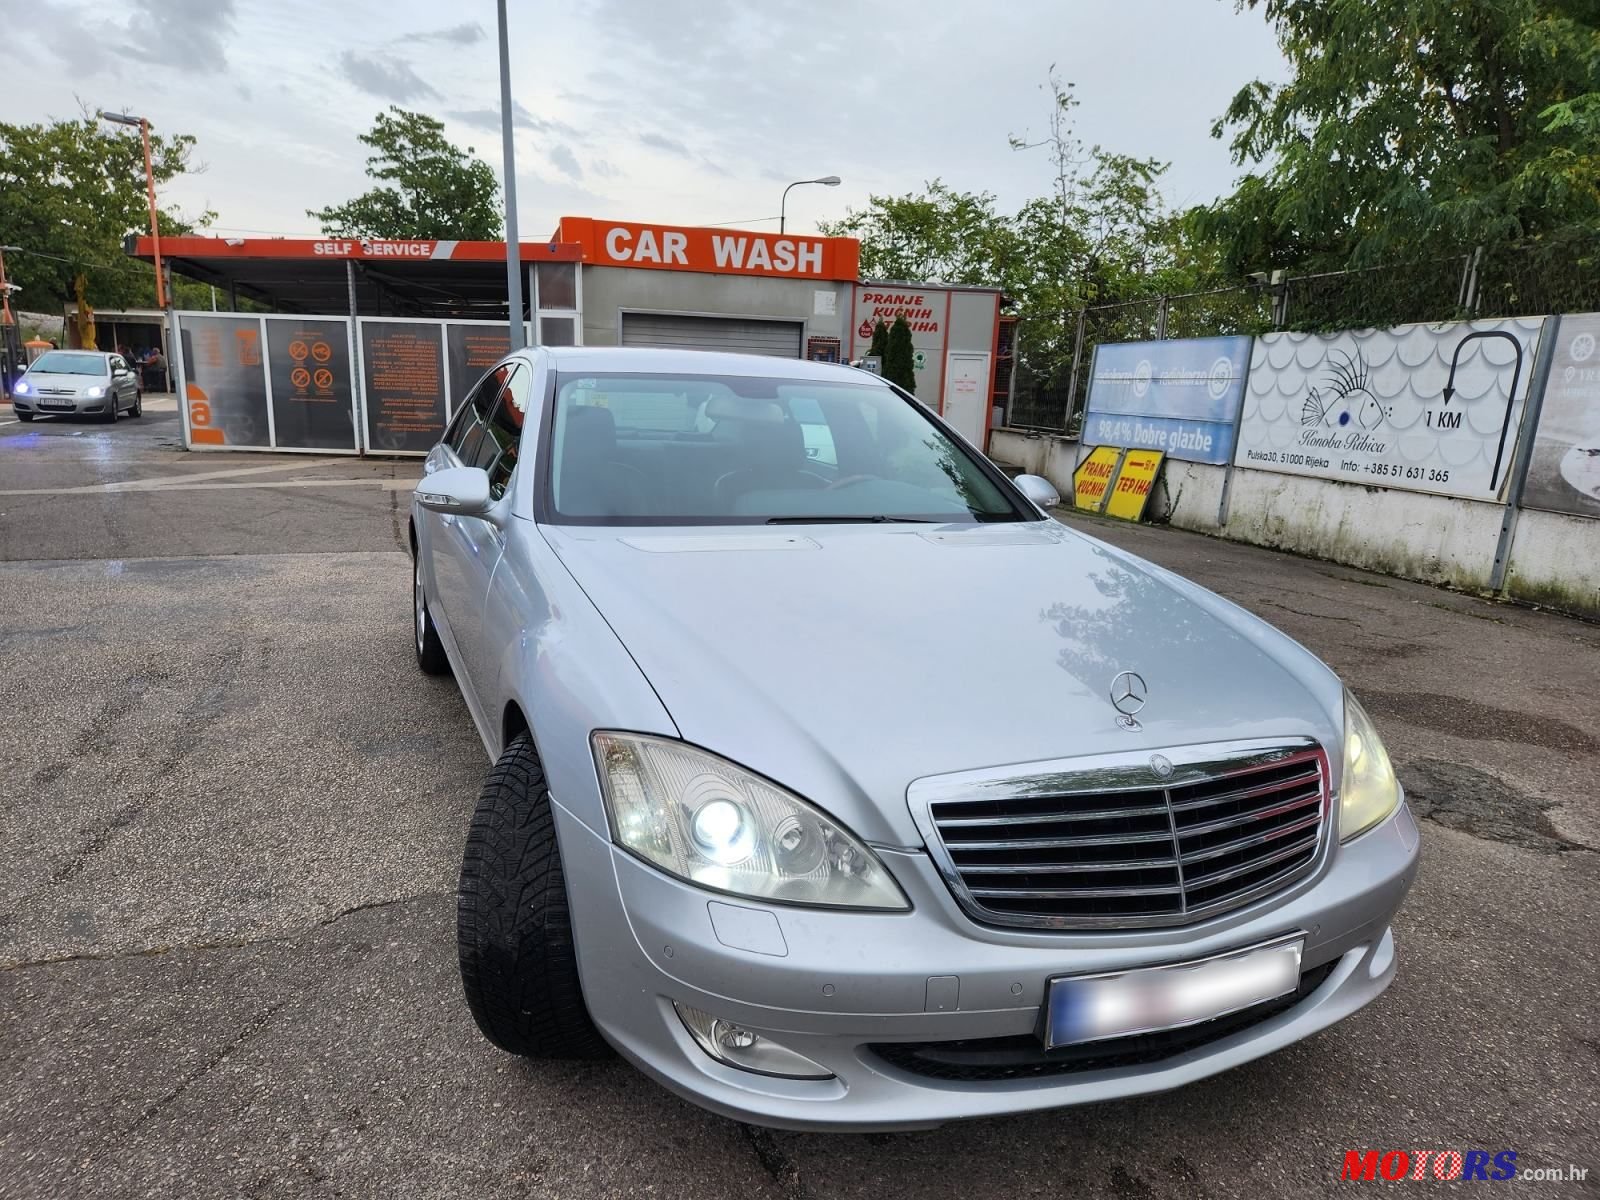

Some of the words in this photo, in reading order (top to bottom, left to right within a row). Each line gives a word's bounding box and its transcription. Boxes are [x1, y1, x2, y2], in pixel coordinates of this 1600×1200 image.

[313, 242, 352, 255] SELF
[363, 243, 431, 256] SERVICE
[605, 227, 689, 265] CAR
[711, 235, 823, 274] WASH
[863, 293, 924, 306] PRANJE
[1426, 411, 1432, 427] 1
[1437, 411, 1462, 429] KM
[1134, 423, 1167, 446] Dobre
[1168, 425, 1213, 453] glazbe
[1298, 429, 1342, 449] Konoba
[1343, 432, 1386, 453] Ribica
[1084, 461, 1114, 479] PRANJE
[1280, 453, 1304, 465] 51000
[1305, 455, 1330, 469] Rijeka
[1340, 460, 1361, 473] Info:
[1363, 463, 1388, 476] +385
[1391, 465, 1403, 477] 51
[1406, 467, 1425, 480] 631
[1428, 469, 1449, 482] 365
[1117, 477, 1152, 496] TEPIHA
